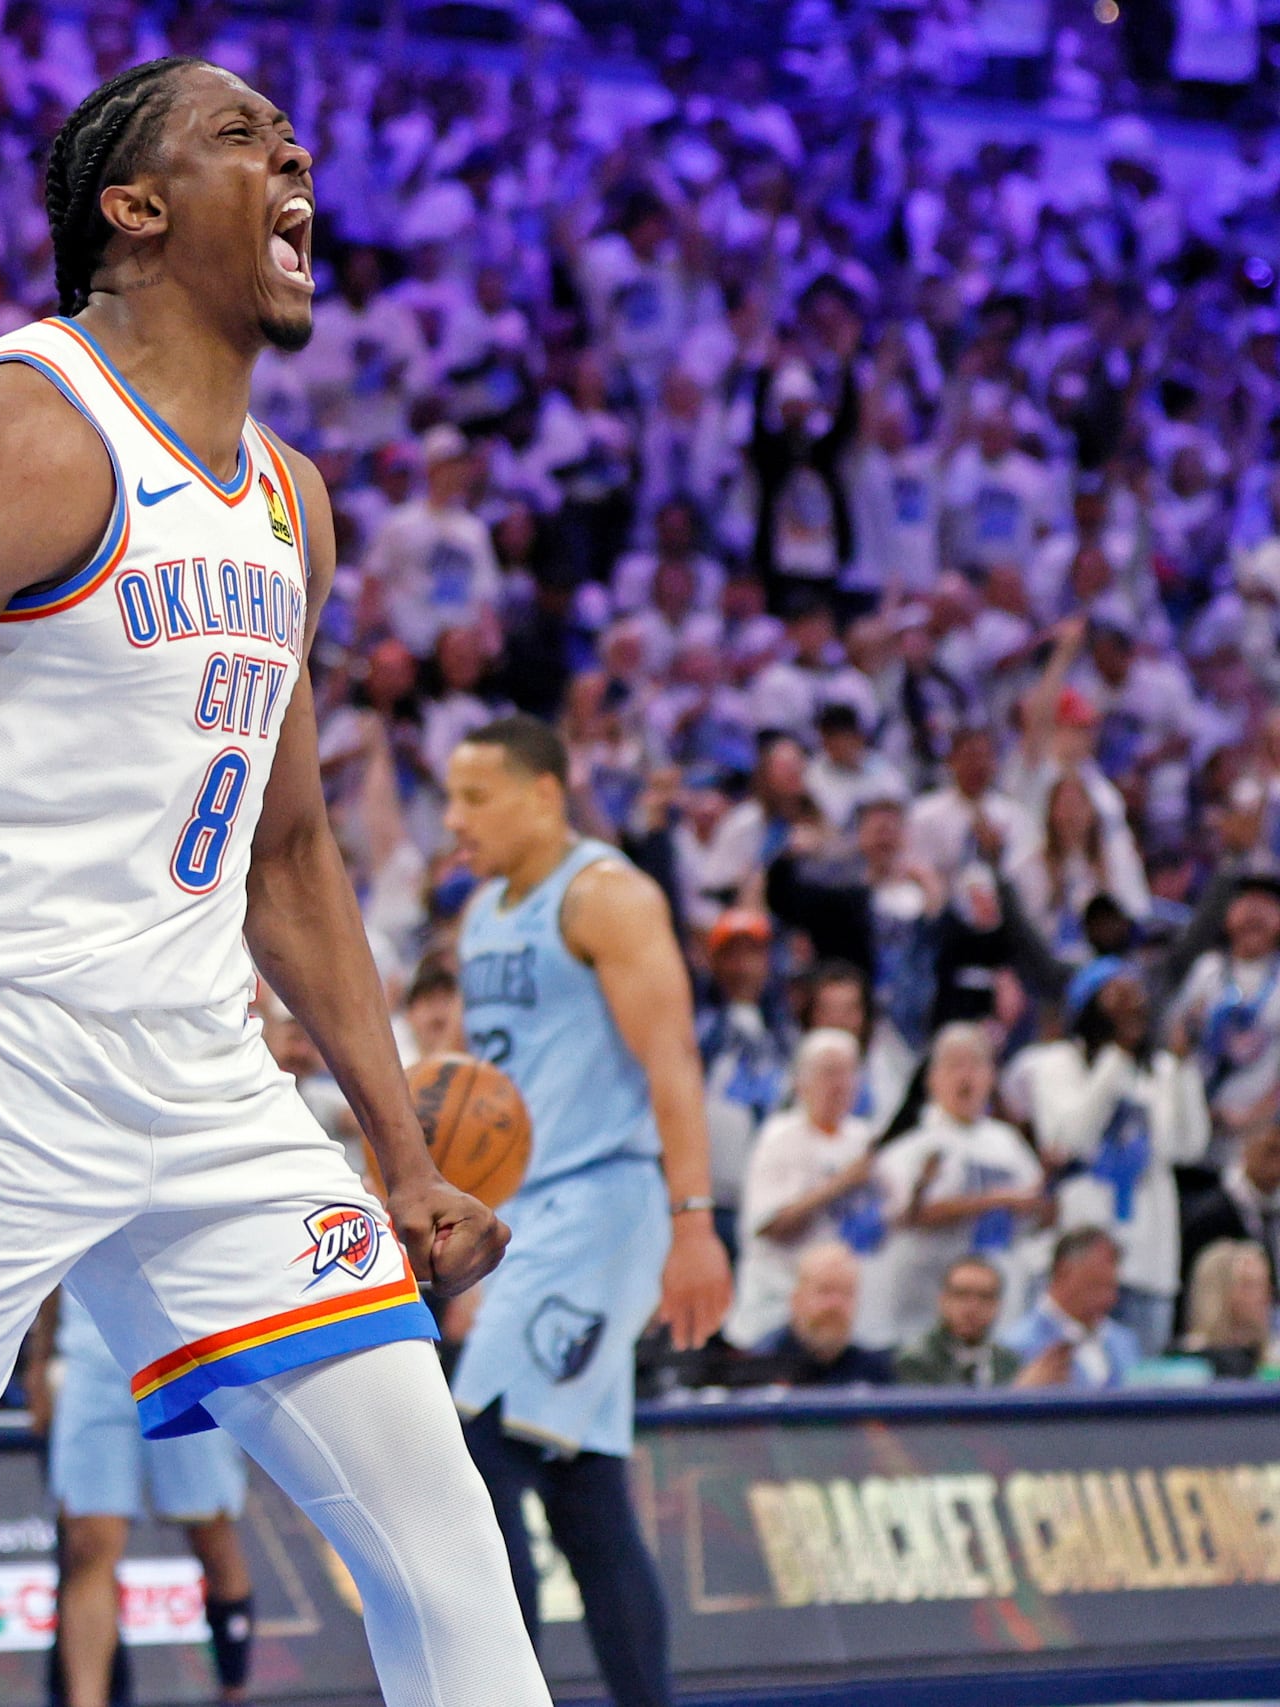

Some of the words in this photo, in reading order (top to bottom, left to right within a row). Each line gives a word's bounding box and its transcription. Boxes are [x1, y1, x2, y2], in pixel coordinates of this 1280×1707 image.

[114, 557, 307, 664] OKLAHOM
[194, 651, 288, 739] CITY
[170, 746, 251, 895] 8
[314, 1217, 367, 1274] OKC
[747, 1473, 1016, 1607] BRACKET
